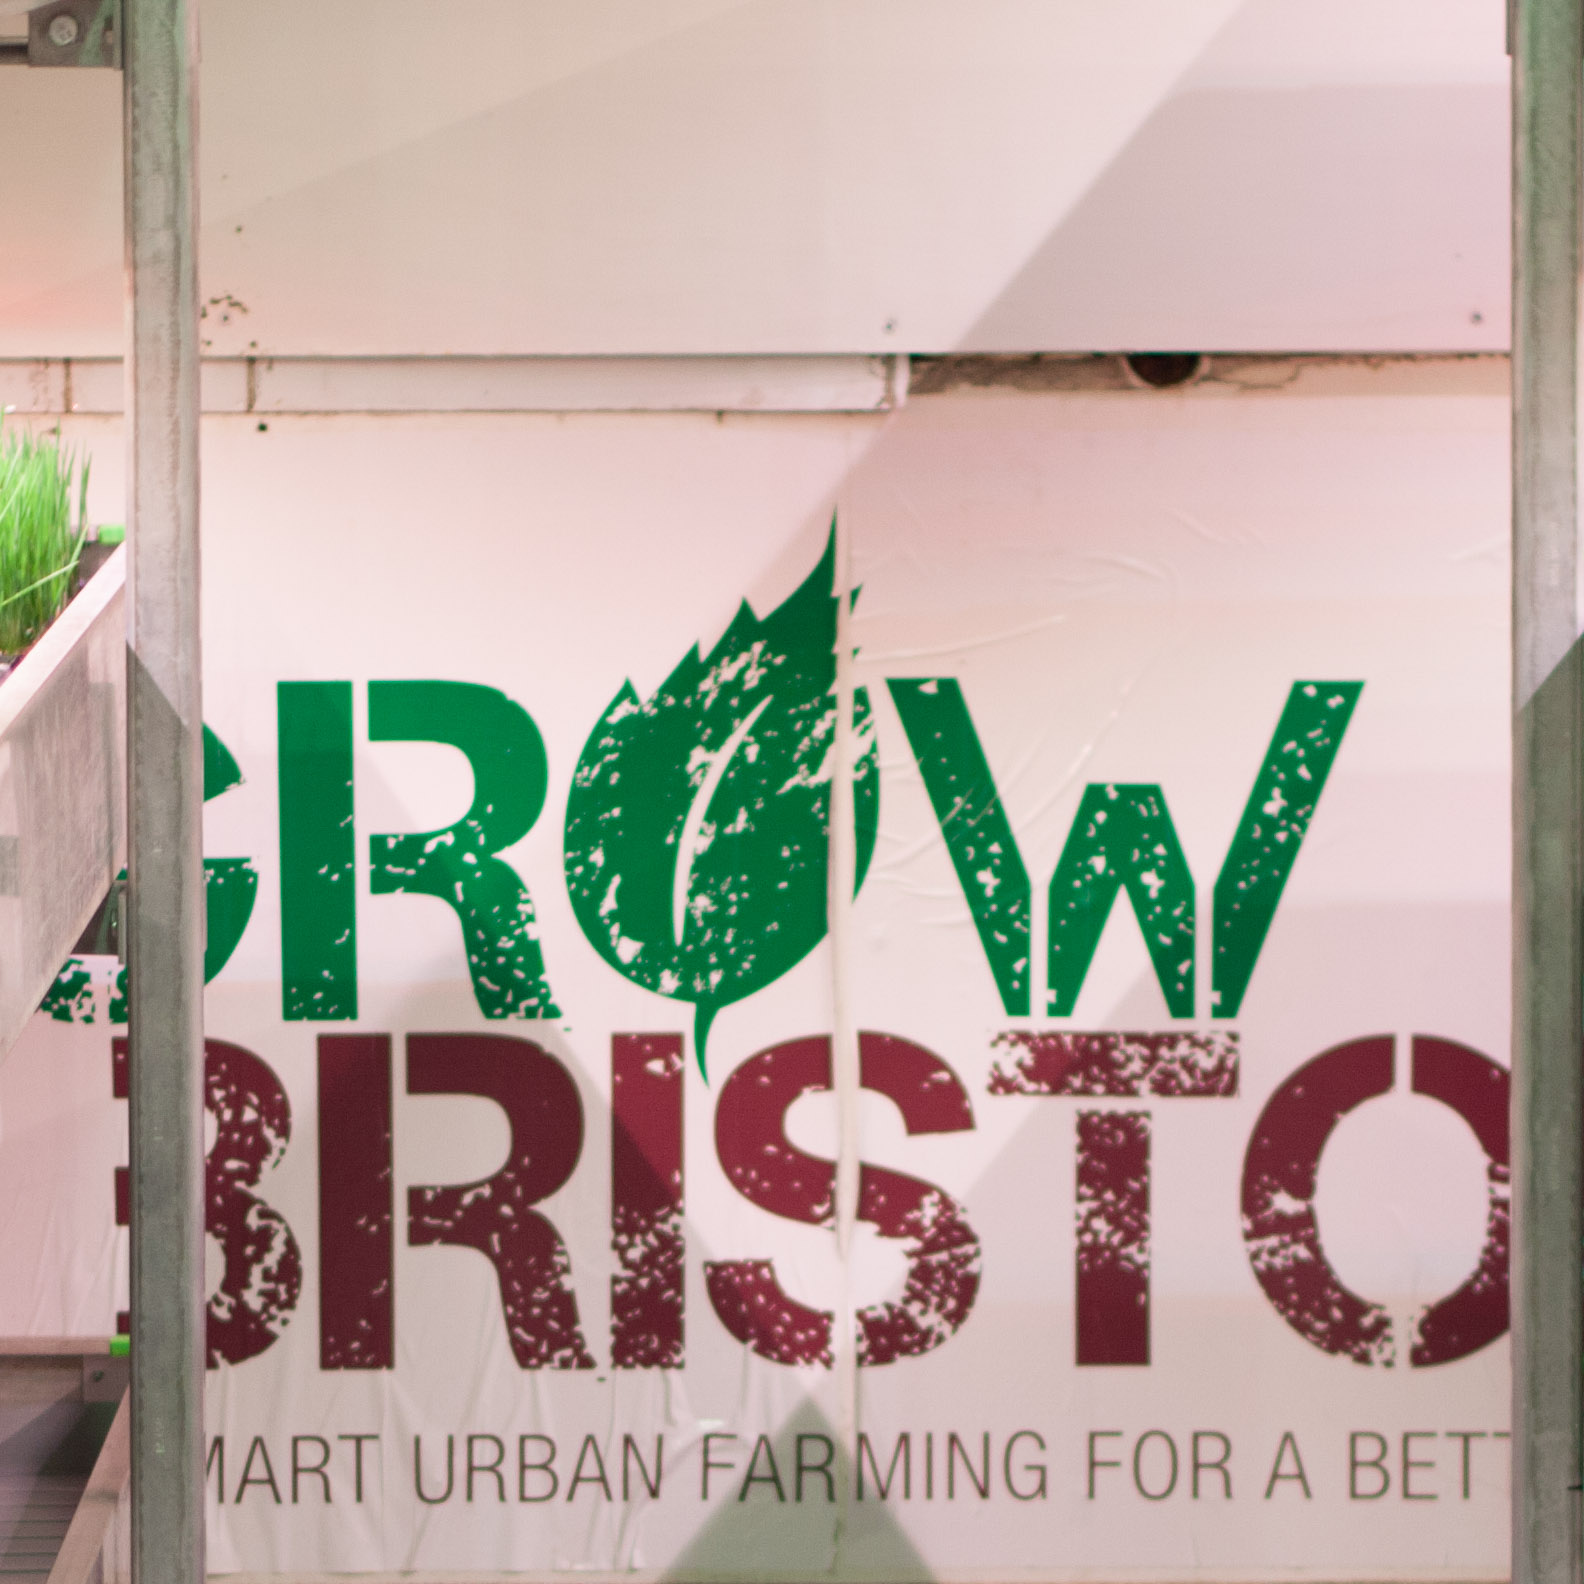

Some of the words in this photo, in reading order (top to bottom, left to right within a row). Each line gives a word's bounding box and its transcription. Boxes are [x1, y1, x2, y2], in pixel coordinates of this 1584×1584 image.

[414, 1433, 664, 1505] URBAN
[702, 1430, 1048, 1502] FARMING
[1087, 1430, 1233, 1500] FOR
[1263, 1431, 1312, 1500] A
[1348, 1430, 1511, 1501] BET
